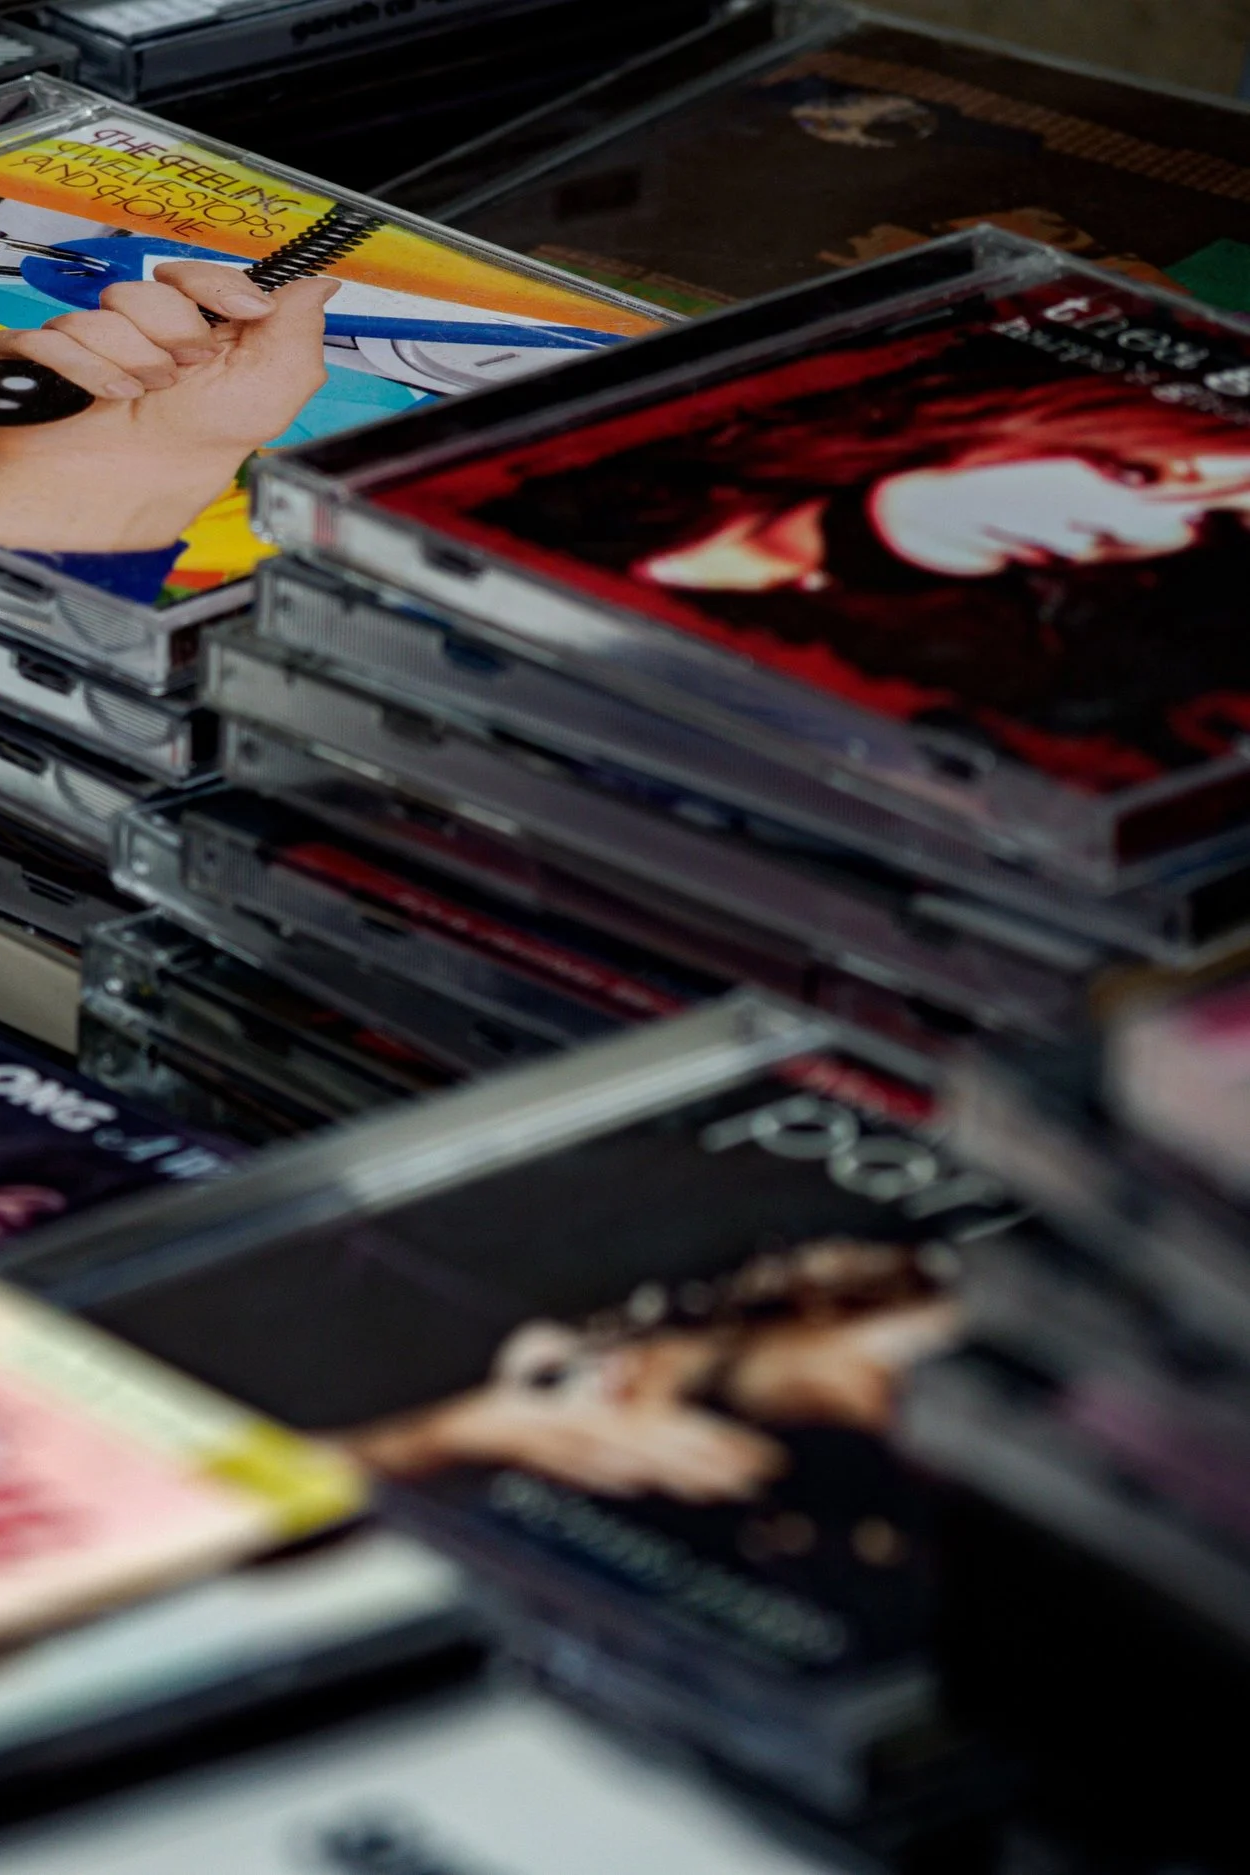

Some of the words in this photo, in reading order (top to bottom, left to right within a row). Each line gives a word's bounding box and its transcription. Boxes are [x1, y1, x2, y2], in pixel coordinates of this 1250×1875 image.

[10, 154, 99, 189] AND
[96, 184, 217, 239] HOME
[56, 141, 177, 198] TWELVE
[166, 191, 287, 240] STOPS
[93, 128, 168, 162] THE
[158, 153, 303, 217] FEELING
